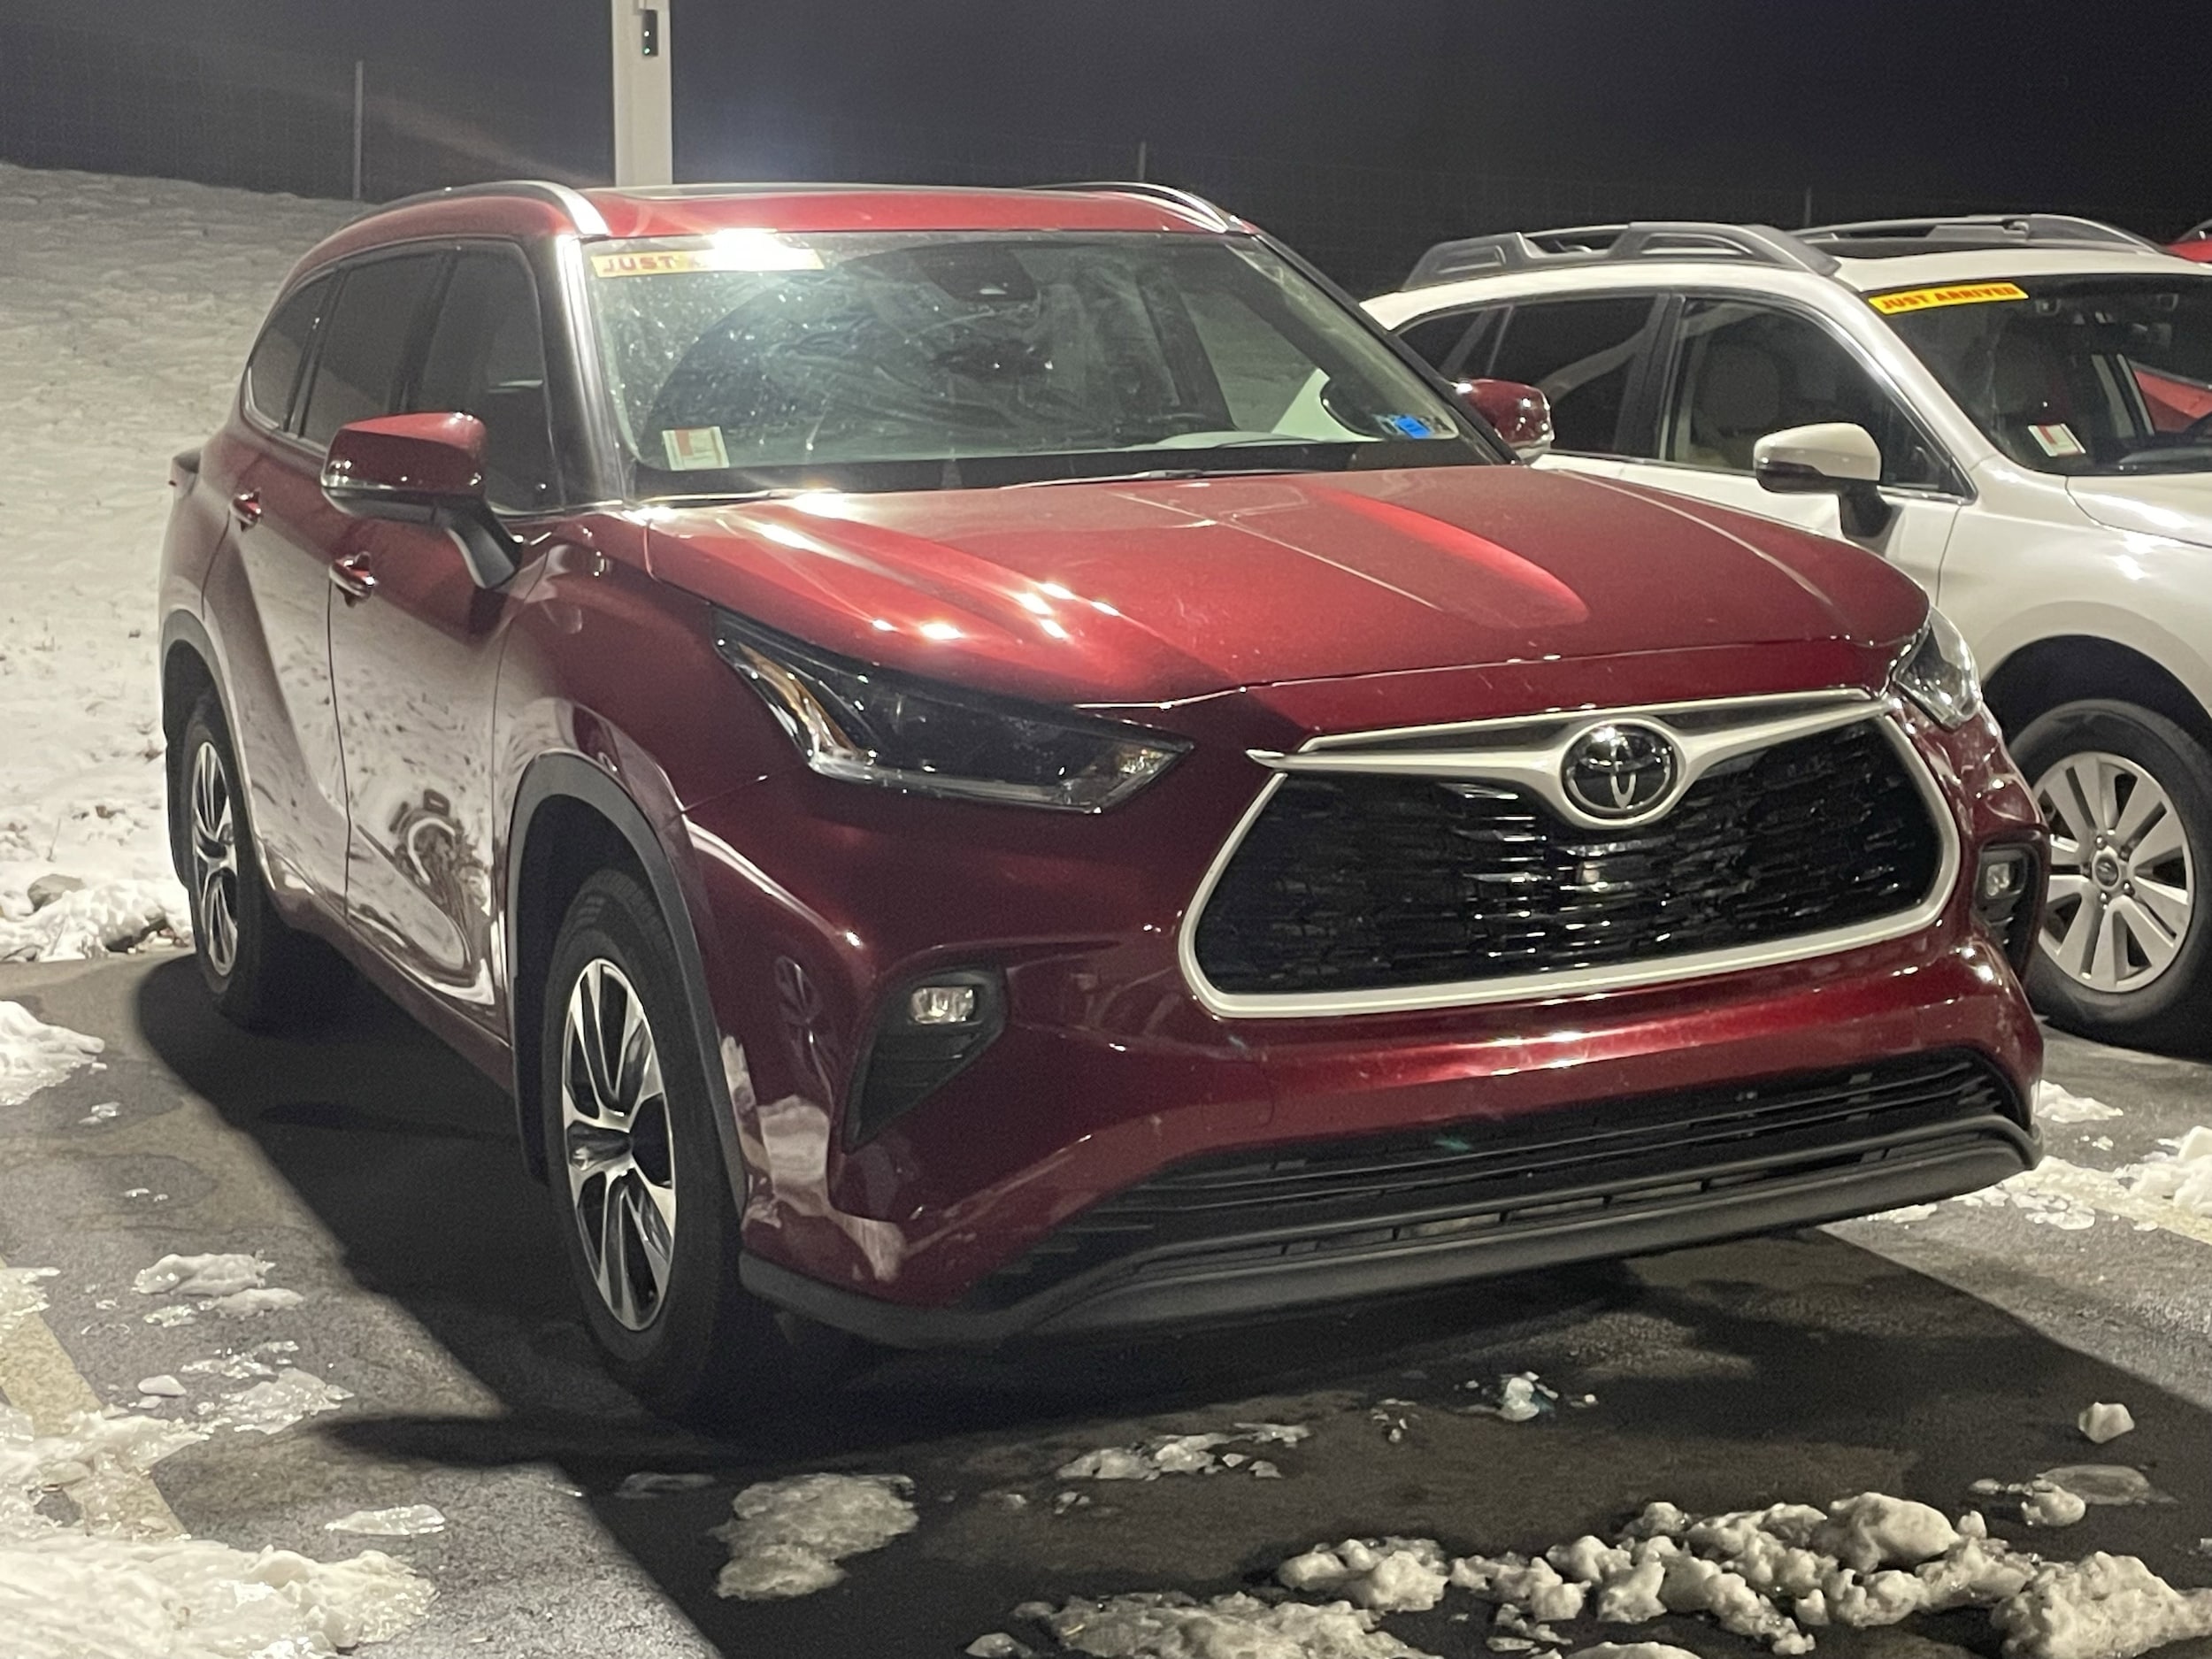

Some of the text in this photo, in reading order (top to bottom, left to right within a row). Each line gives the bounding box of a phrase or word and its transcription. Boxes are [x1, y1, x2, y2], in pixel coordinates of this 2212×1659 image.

[603, 256, 676, 272] JUST
[1882, 288, 2018, 309] JUST ARRIVED
